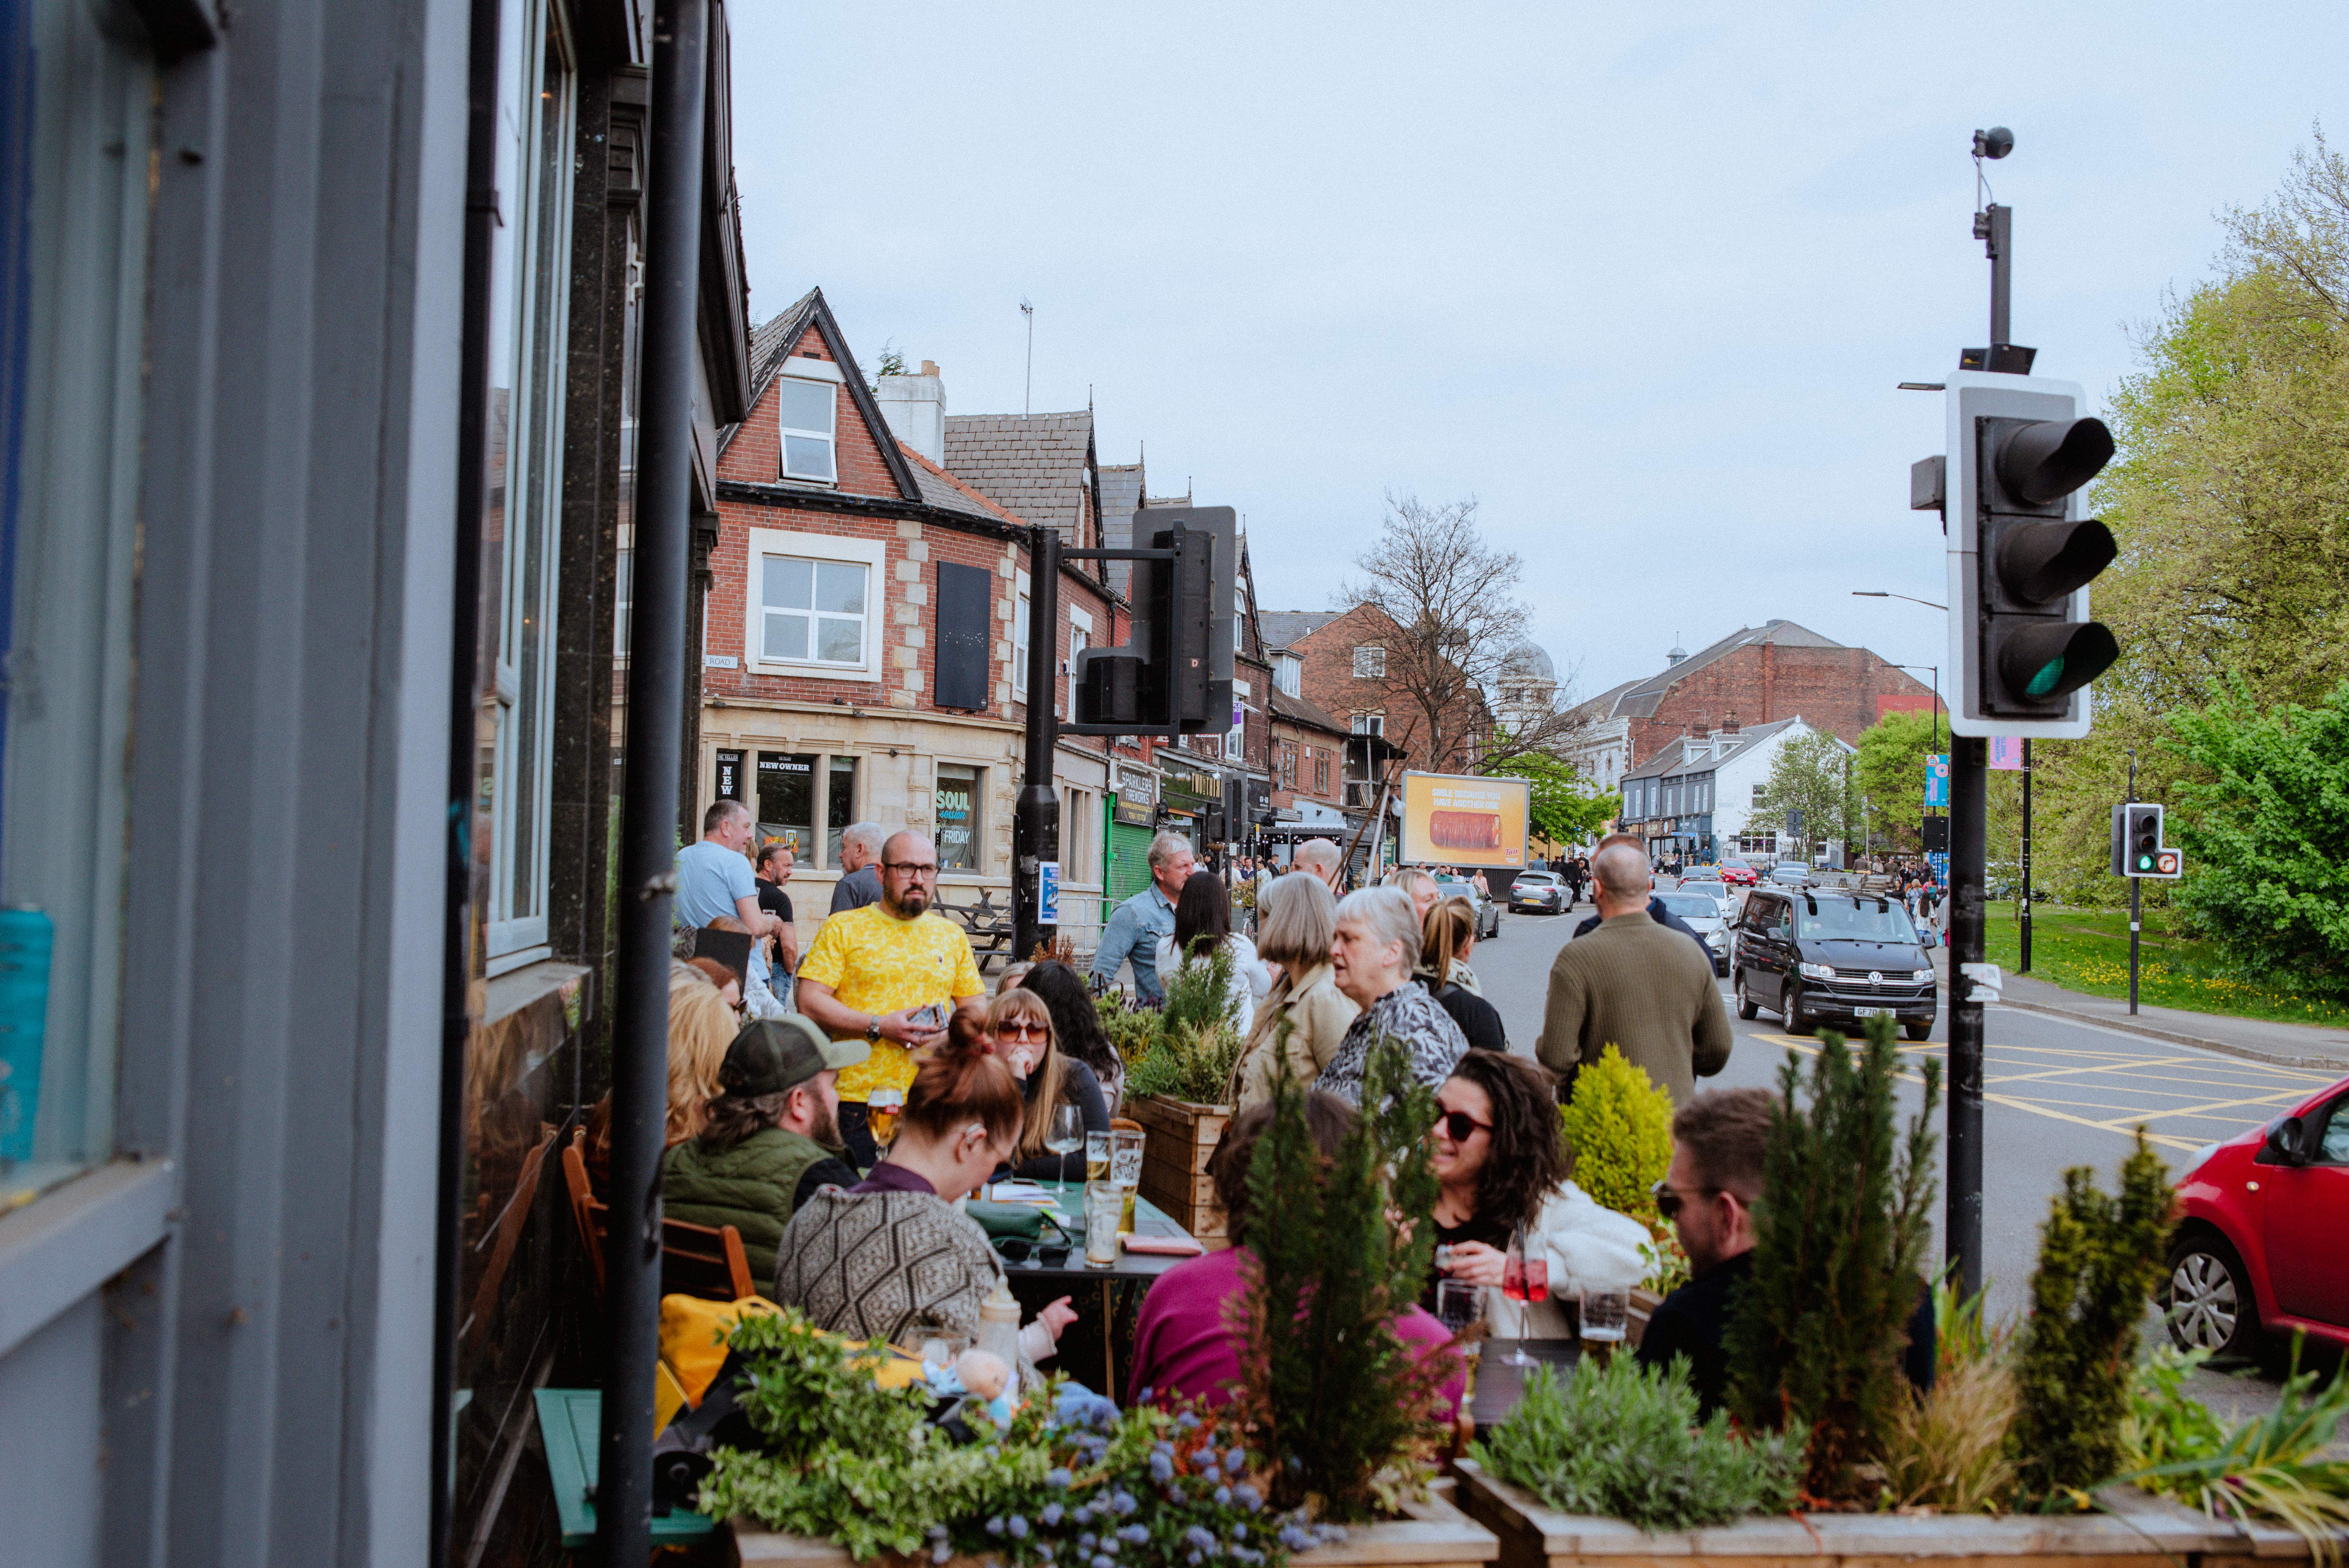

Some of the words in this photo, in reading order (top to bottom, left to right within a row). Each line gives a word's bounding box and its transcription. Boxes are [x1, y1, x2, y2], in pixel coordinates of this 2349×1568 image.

[779, 763, 810, 772] OWNER
[721, 766, 733, 795] NEW
[1122, 772, 1152, 793] SPARKLERS
[1192, 772, 1202, 794] TWO
[936, 790, 970, 811] SOUL
[1125, 788, 1150, 804] FIREWORKS
[1432, 788, 1453, 797] SMILE
[1454, 790, 1485, 800] BECAUSE
[1487, 792, 1500, 800] YOU
[1433, 798, 1451, 806] HAVE
[1452, 799, 1484, 809] ANOTHER
[1485, 801, 1499, 809] ONE
[939, 810, 966, 820] session
[944, 830, 970, 844] FRIDAY
